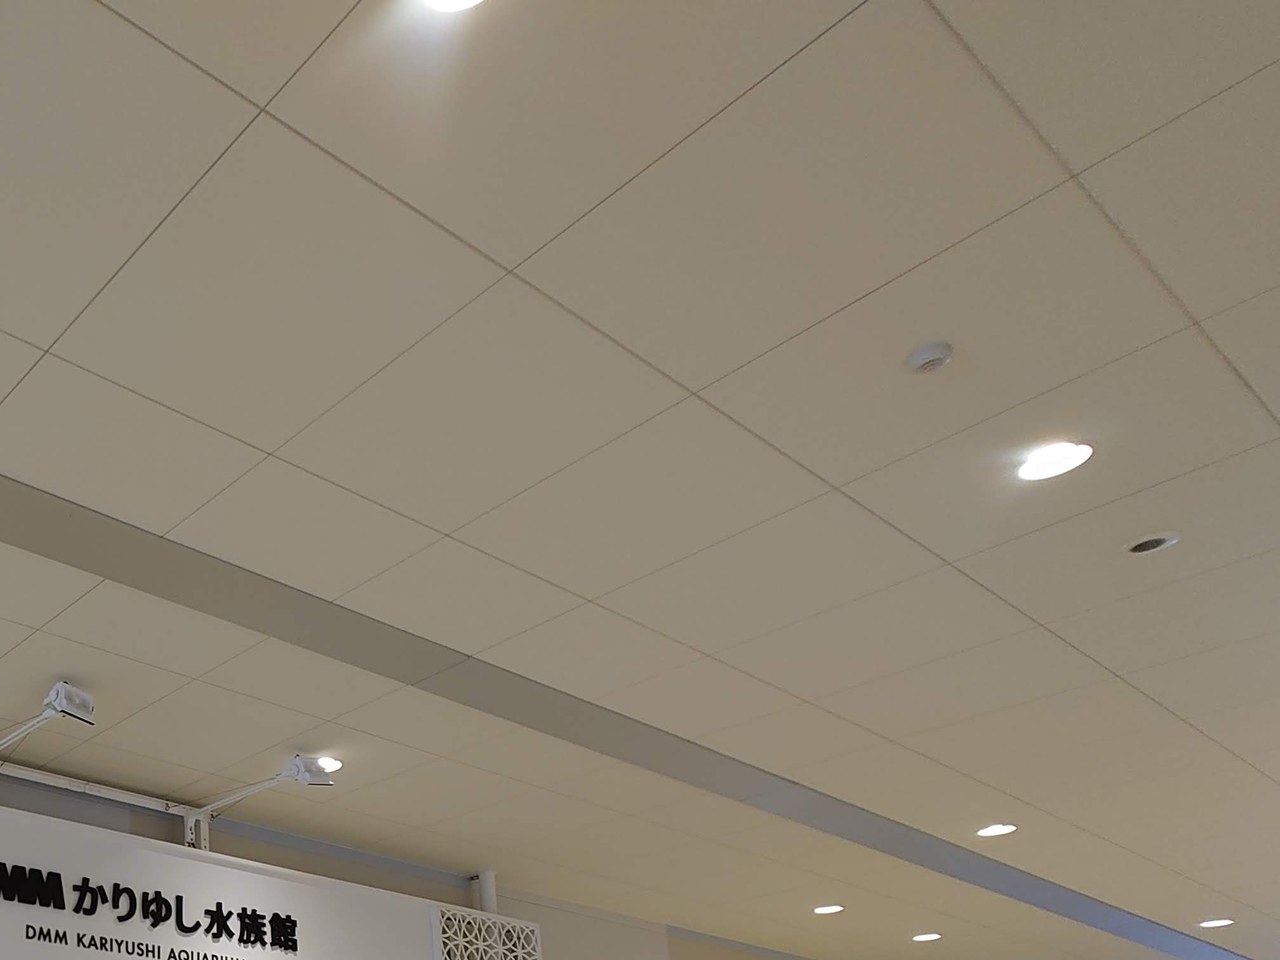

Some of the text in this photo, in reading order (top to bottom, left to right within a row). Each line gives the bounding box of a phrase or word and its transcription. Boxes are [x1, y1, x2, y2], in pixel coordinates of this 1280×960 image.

[25, 924, 69, 946] DMM
[76, 933, 162, 960] KARIYUSHI
[72, 877, 299, 953] かりゆし水族館
